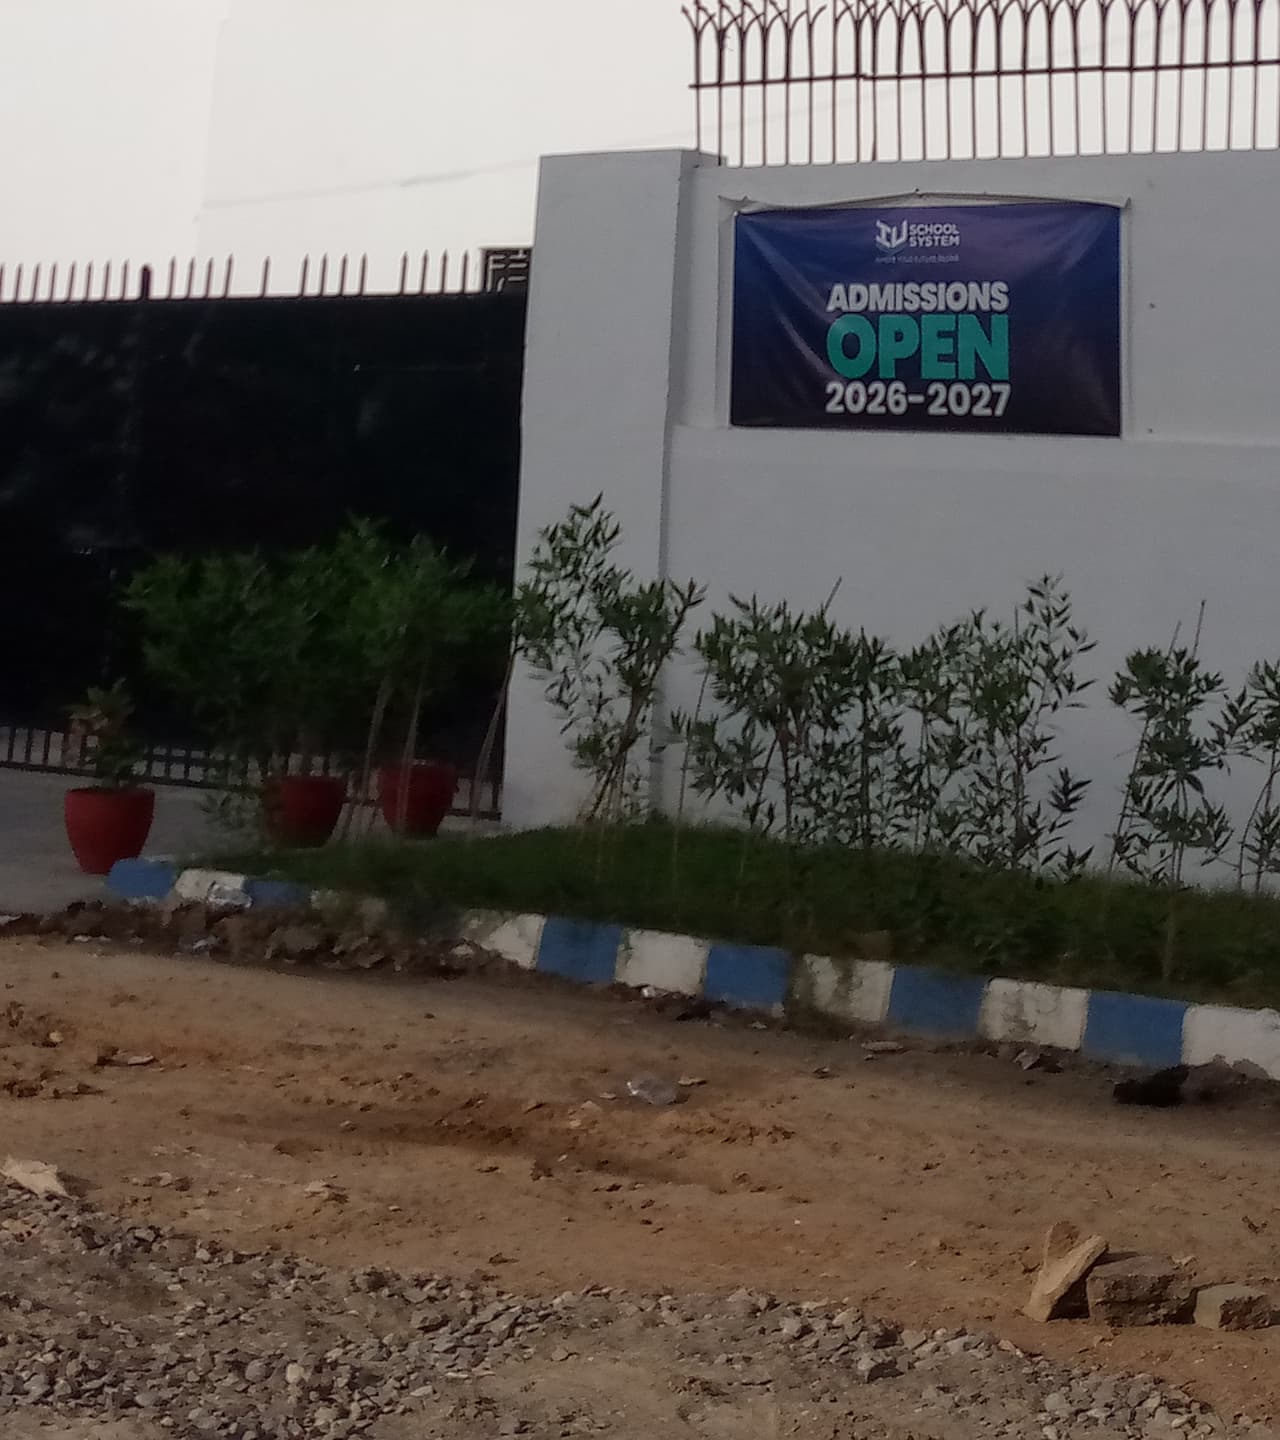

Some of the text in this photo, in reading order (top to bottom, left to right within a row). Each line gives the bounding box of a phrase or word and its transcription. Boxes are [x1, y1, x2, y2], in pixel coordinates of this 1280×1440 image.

[909, 223, 960, 236] SCHOOL
[909, 235, 960, 248] SYSTEM
[826, 281, 1010, 312] ADMISSIONS
[827, 314, 1009, 380] OPEN
[825, 381, 1011, 417] 2026-2027
